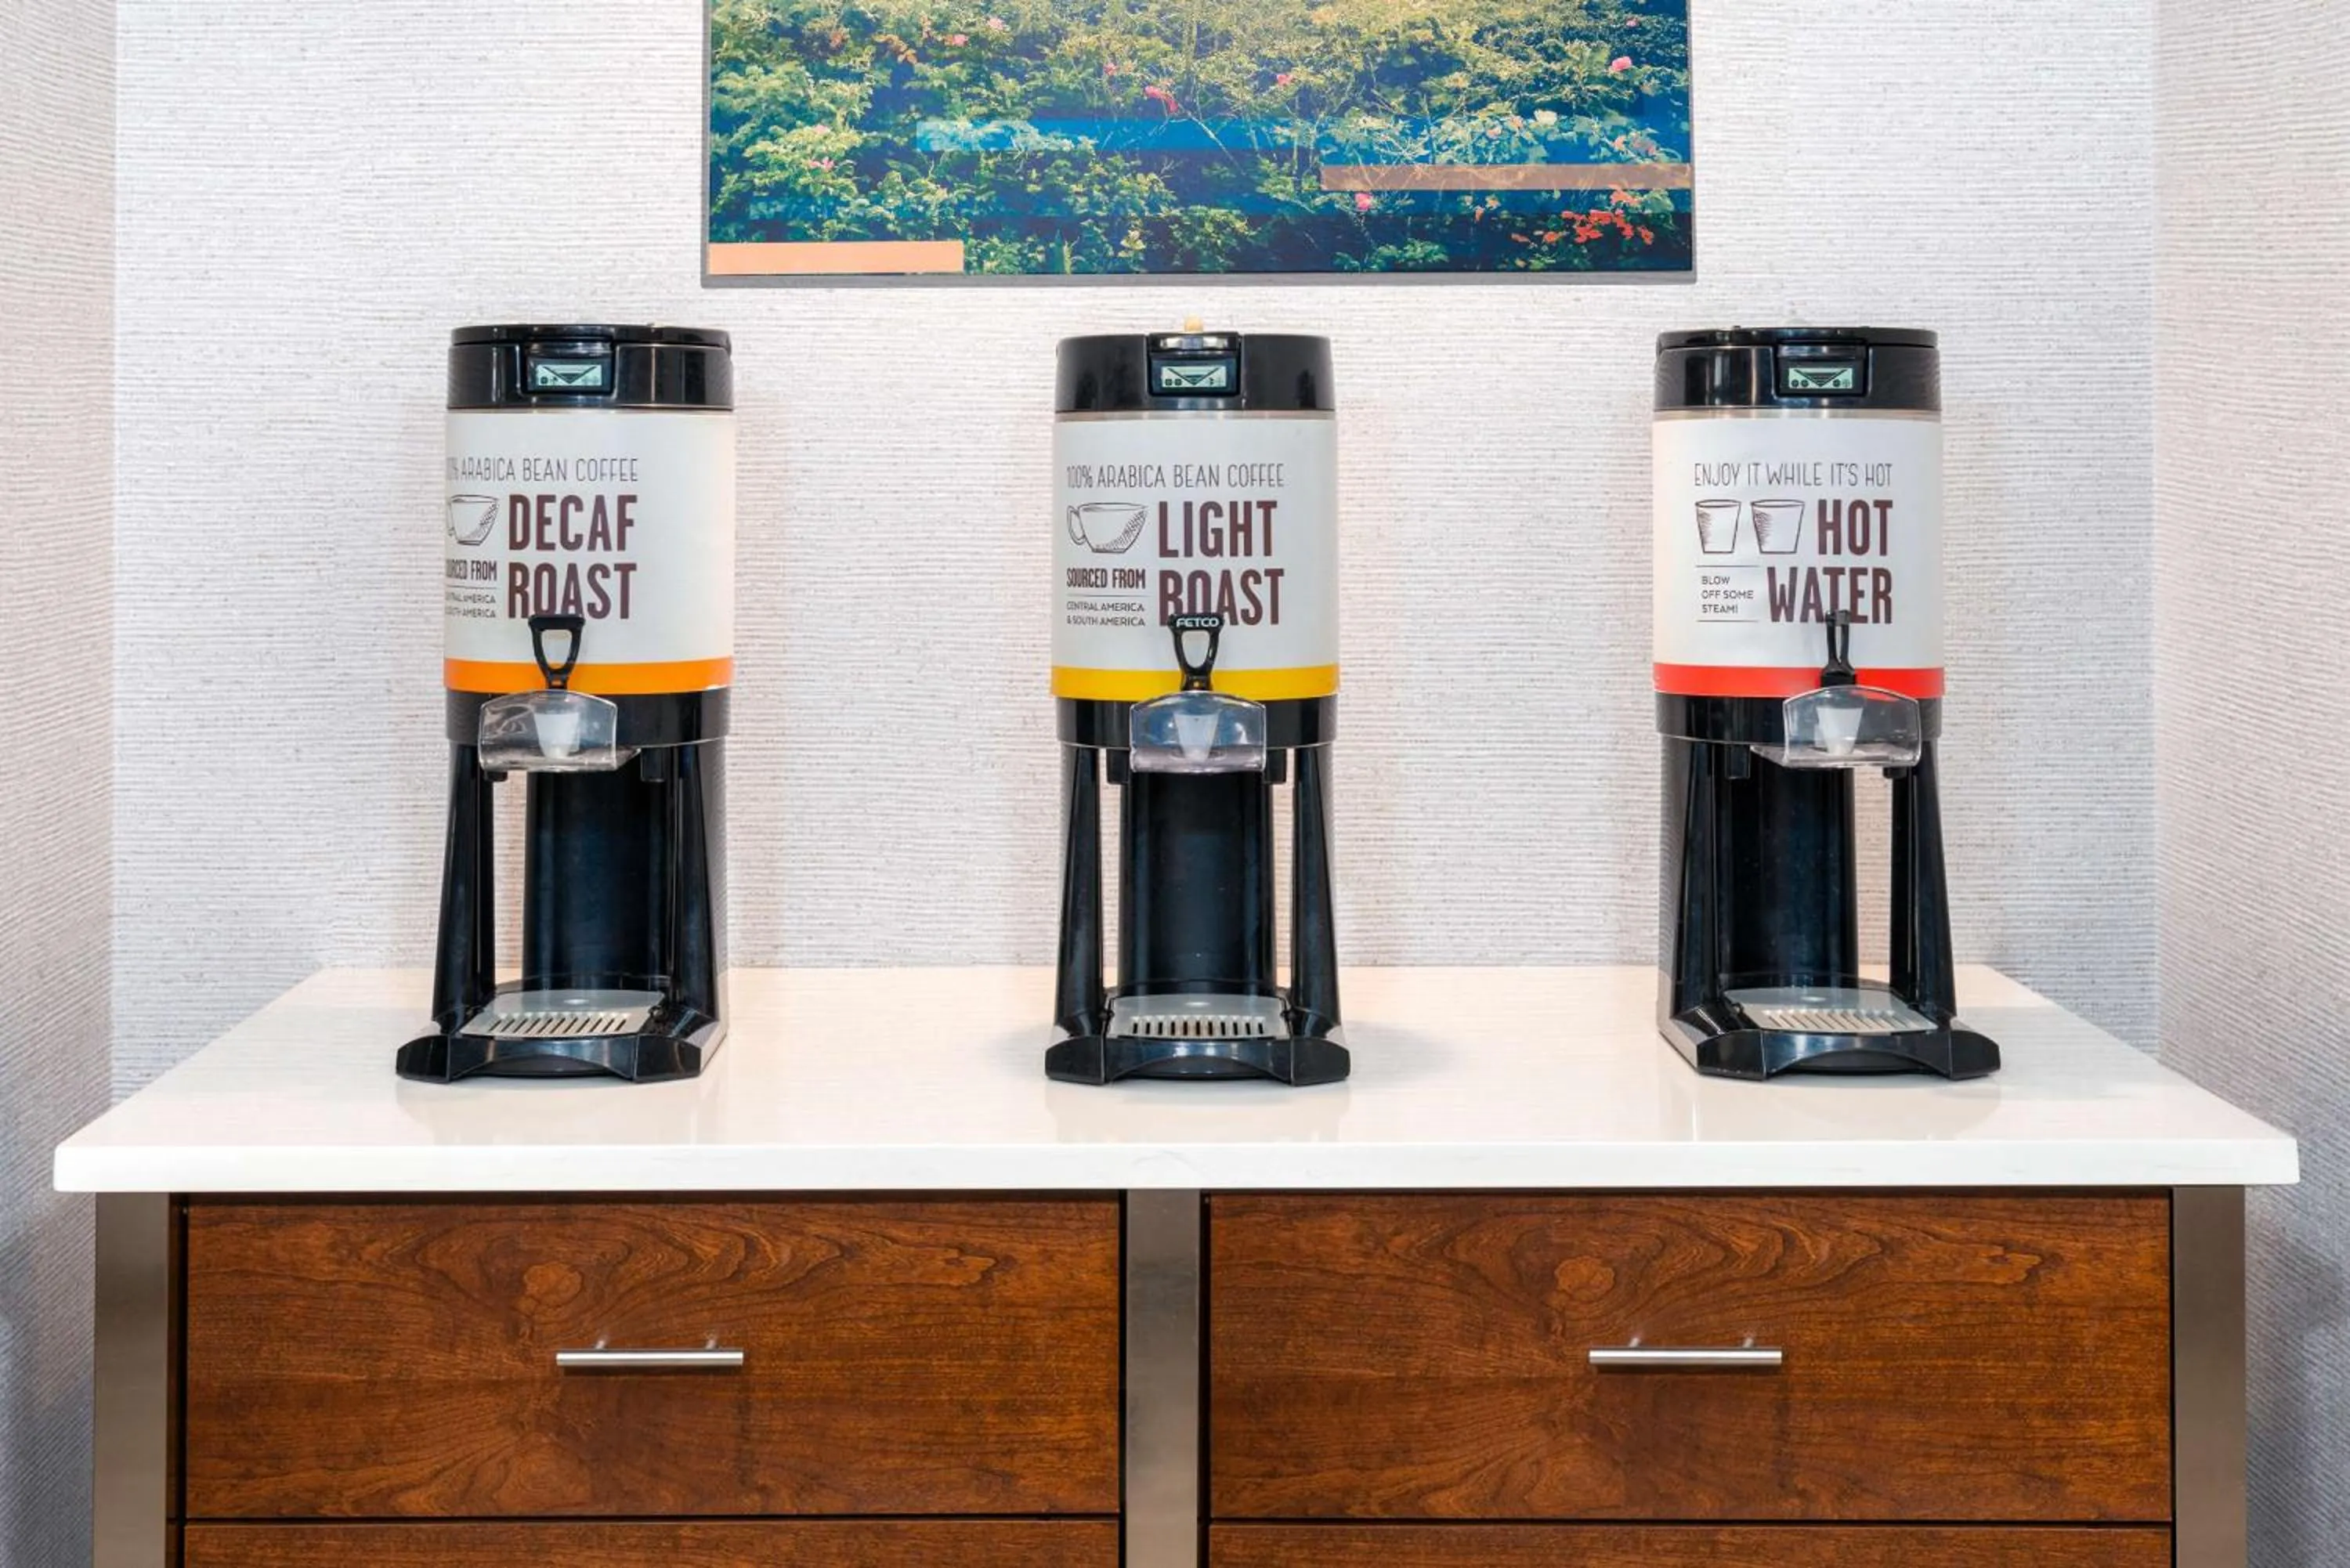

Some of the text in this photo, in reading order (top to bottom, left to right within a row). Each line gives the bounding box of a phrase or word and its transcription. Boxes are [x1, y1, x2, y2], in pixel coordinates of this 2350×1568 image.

[461, 457, 516, 482] ARABICA
[522, 457, 567, 482] BEAN
[576, 458, 638, 482] COFFEE
[1066, 464, 1285, 488] 100% ARABICA BEAN COFFEE
[1694, 462, 1893, 486] ENJOY IT WHILE IT'S HOT
[508, 494, 638, 551] DECAF
[1159, 500, 1278, 558] LIGHT
[1817, 499, 1893, 556] HOT
[471, 560, 497, 580] FROM
[1066, 568, 1146, 589] SOURCED FROM
[1701, 576, 1730, 585] BLOW
[508, 562, 638, 620] ROAST
[1159, 568, 1285, 627] ROAST
[1701, 590, 1754, 599] OFF SOME
[1767, 566, 1893, 624] WATER
[1066, 601, 1146, 612] CENTRAL AMERICA
[1073, 615, 1098, 626] SOUTH
[1100, 616, 1146, 627] AMERICA
[1176, 617, 1220, 627] FETCO
